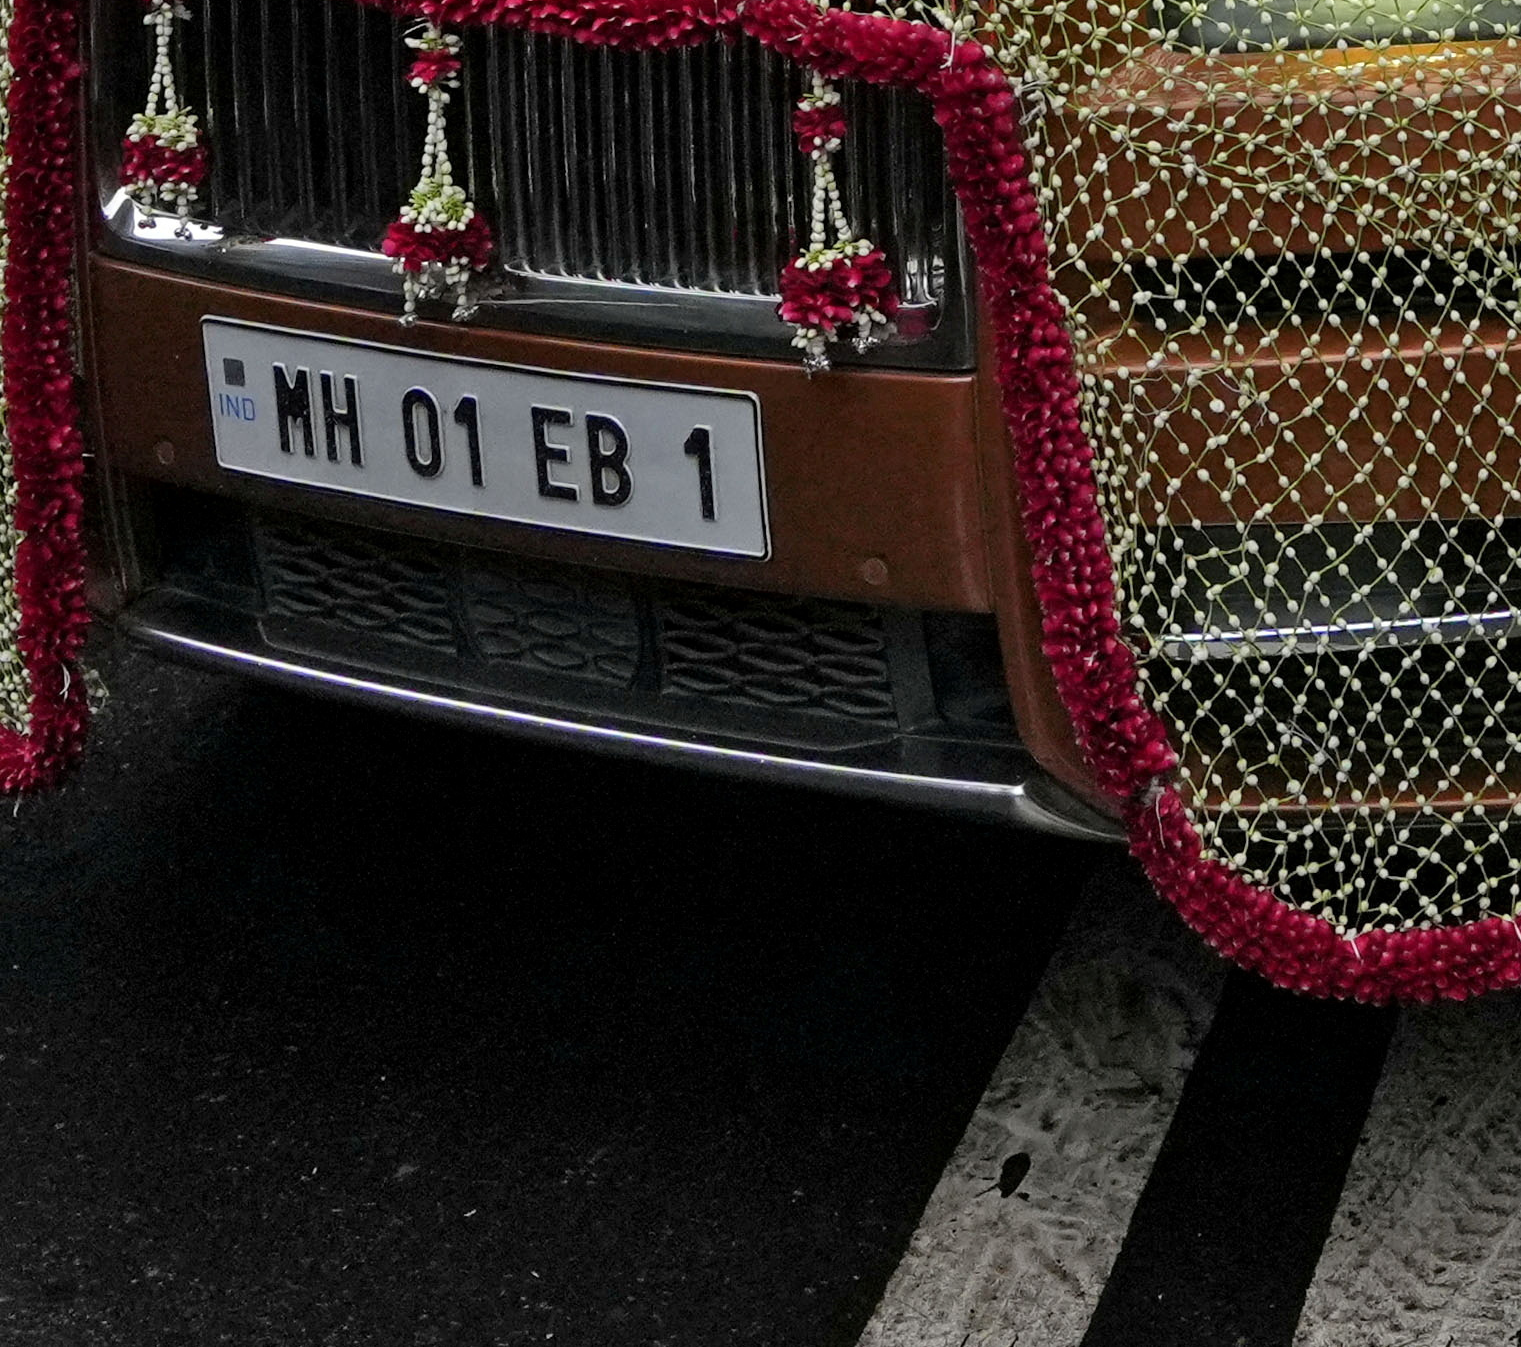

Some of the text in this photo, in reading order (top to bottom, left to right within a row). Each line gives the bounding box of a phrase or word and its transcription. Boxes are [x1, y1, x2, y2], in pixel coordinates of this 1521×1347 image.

[218, 392, 257, 423] IND
[271, 361, 719, 523] MH 01 EB 1
